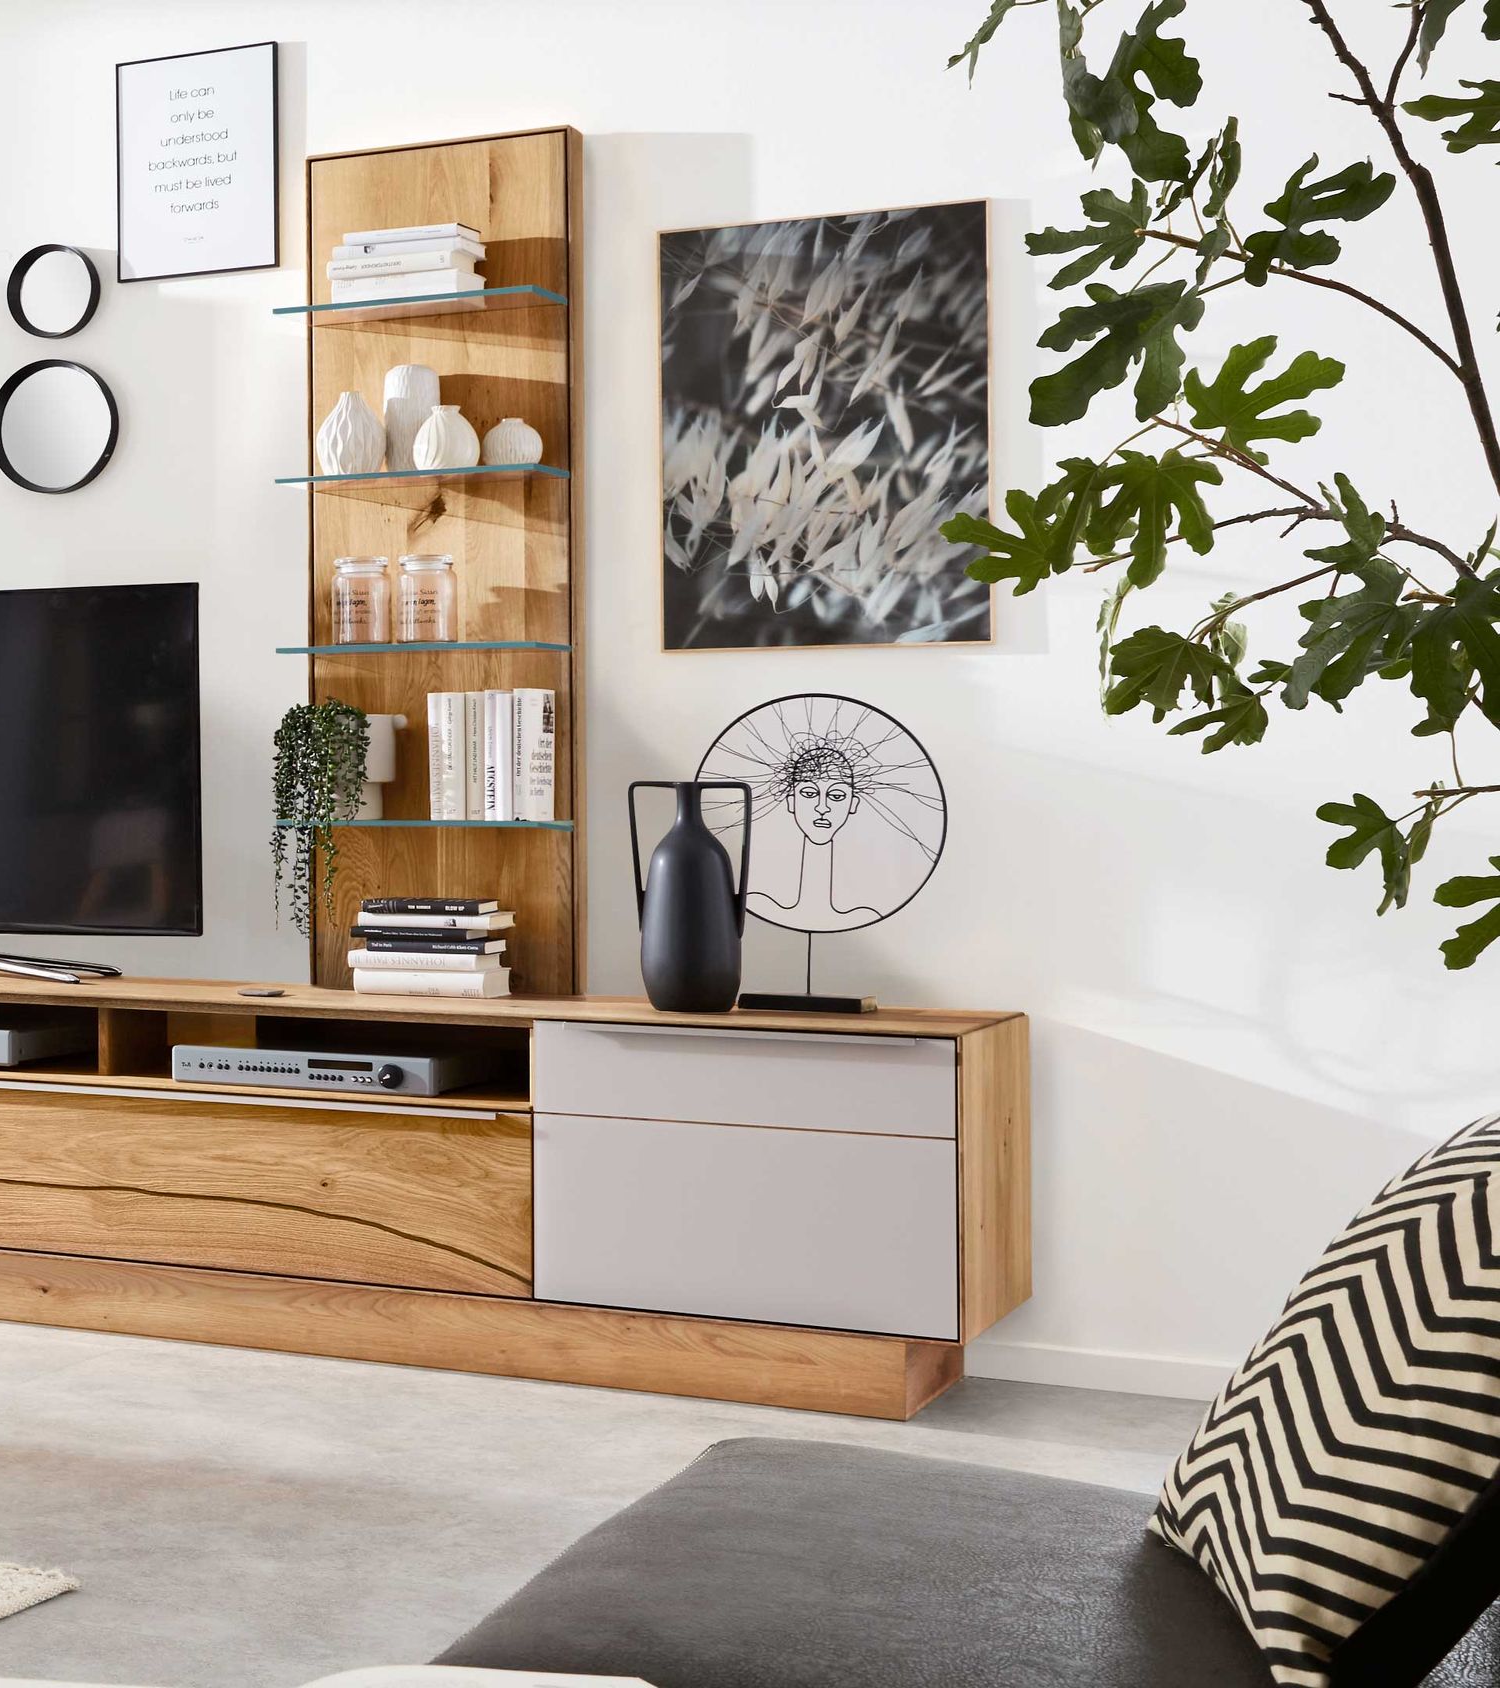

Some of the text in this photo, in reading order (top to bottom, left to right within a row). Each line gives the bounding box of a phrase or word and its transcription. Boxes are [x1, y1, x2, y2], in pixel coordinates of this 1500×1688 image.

[169, 86, 215, 101] Life can
[170, 108, 214, 124] only be
[160, 129, 229, 147] understood
[148, 151, 237, 172] backwards, but
[154, 174, 232, 193] must be lived
[170, 199, 219, 214] forwards
[486, 765, 496, 810] AUGSTEIN
